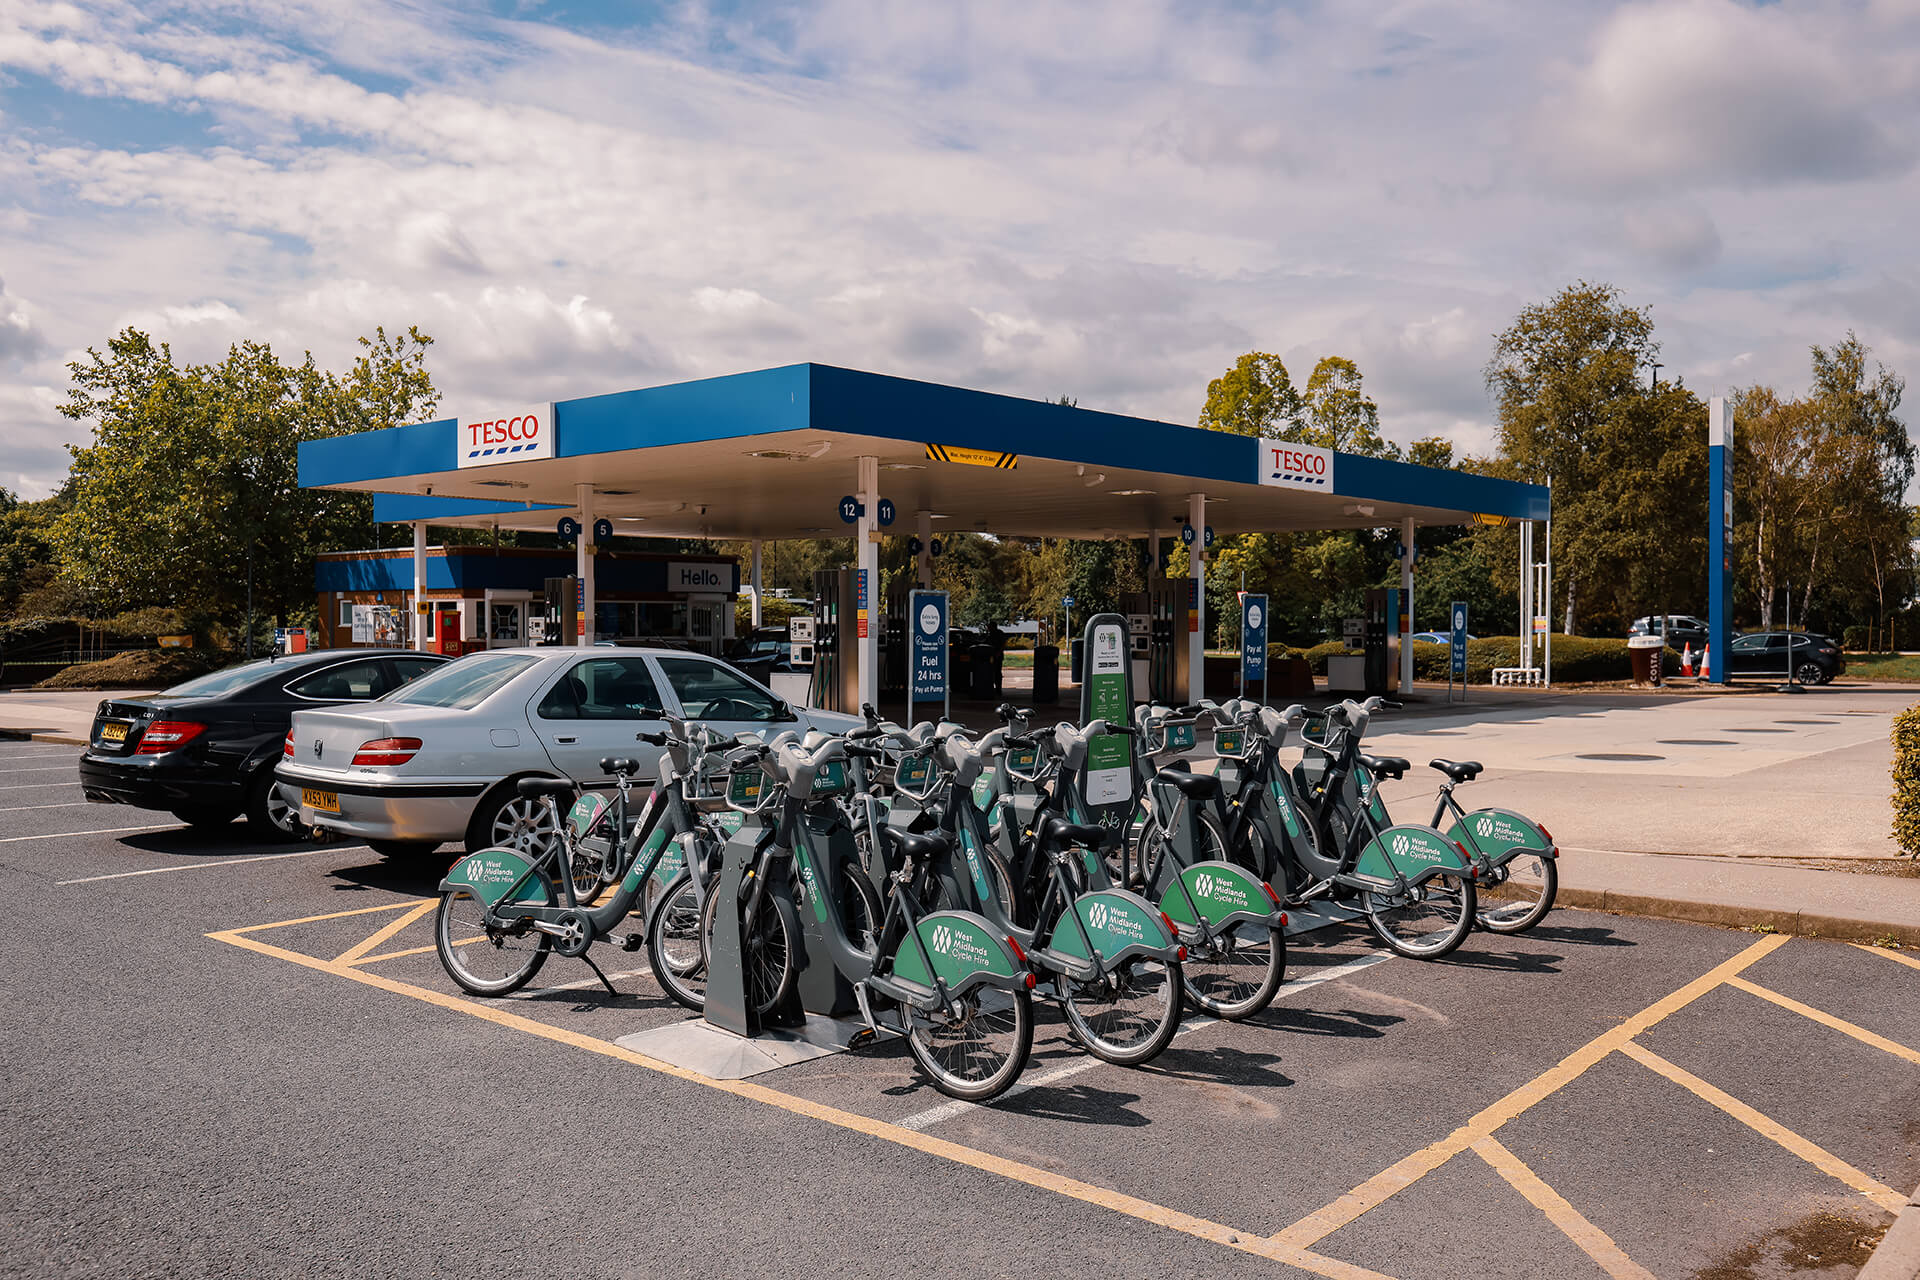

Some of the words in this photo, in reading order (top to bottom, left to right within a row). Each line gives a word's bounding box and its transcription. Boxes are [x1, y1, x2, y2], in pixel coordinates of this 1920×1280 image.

[468, 414, 539, 446] TESCO
[1272, 448, 1326, 475] TESCO
[843, 503, 855, 516] 12
[881, 506, 891, 519] 11
[563, 523, 572, 534] 6
[600, 525, 607, 536] 5
[1184, 529, 1192, 540] 10
[1205, 531, 1211, 541] 9
[681, 569, 721, 586] Hello.
[1247, 645, 1256, 655] Pay
[1256, 645, 1262, 653] at
[922, 656, 938, 666] Fuel
[1246, 656, 1262, 665] Pump
[1650, 652, 1658, 682] COSTA
[917, 670, 927, 680] 24
[915, 686, 923, 694] Pay
[930, 685, 944, 694] Pump
[304, 789, 321, 805] KX53
[1495, 820, 1511, 829] West
[1493, 832, 1511, 841] Cycle
[1511, 836, 1526, 844] Hire
[1494, 827, 1523, 838] Midlands
[1411, 837, 1428, 846] West
[1410, 844, 1440, 856] Midlands
[1409, 850, 1427, 860] Cycle
[1428, 854, 1442, 863] Hire
[484, 867, 513, 876] Midlands
[483, 874, 500, 884] Cycle
[1215, 877, 1233, 888] West
[1214, 885, 1247, 898] Midlands
[1213, 892, 1232, 904] Cycle
[1233, 897, 1248, 907] Hire
[1110, 906, 1128, 917] West
[1108, 915, 1142, 930] Midlands
[954, 929, 973, 943] West
[1107, 923, 1128, 937] Cycle
[1128, 929, 1144, 940] Hire
[952, 940, 988, 957] Midlands
[951, 948, 973, 962] Cycle
[974, 955, 990, 966] Hire
